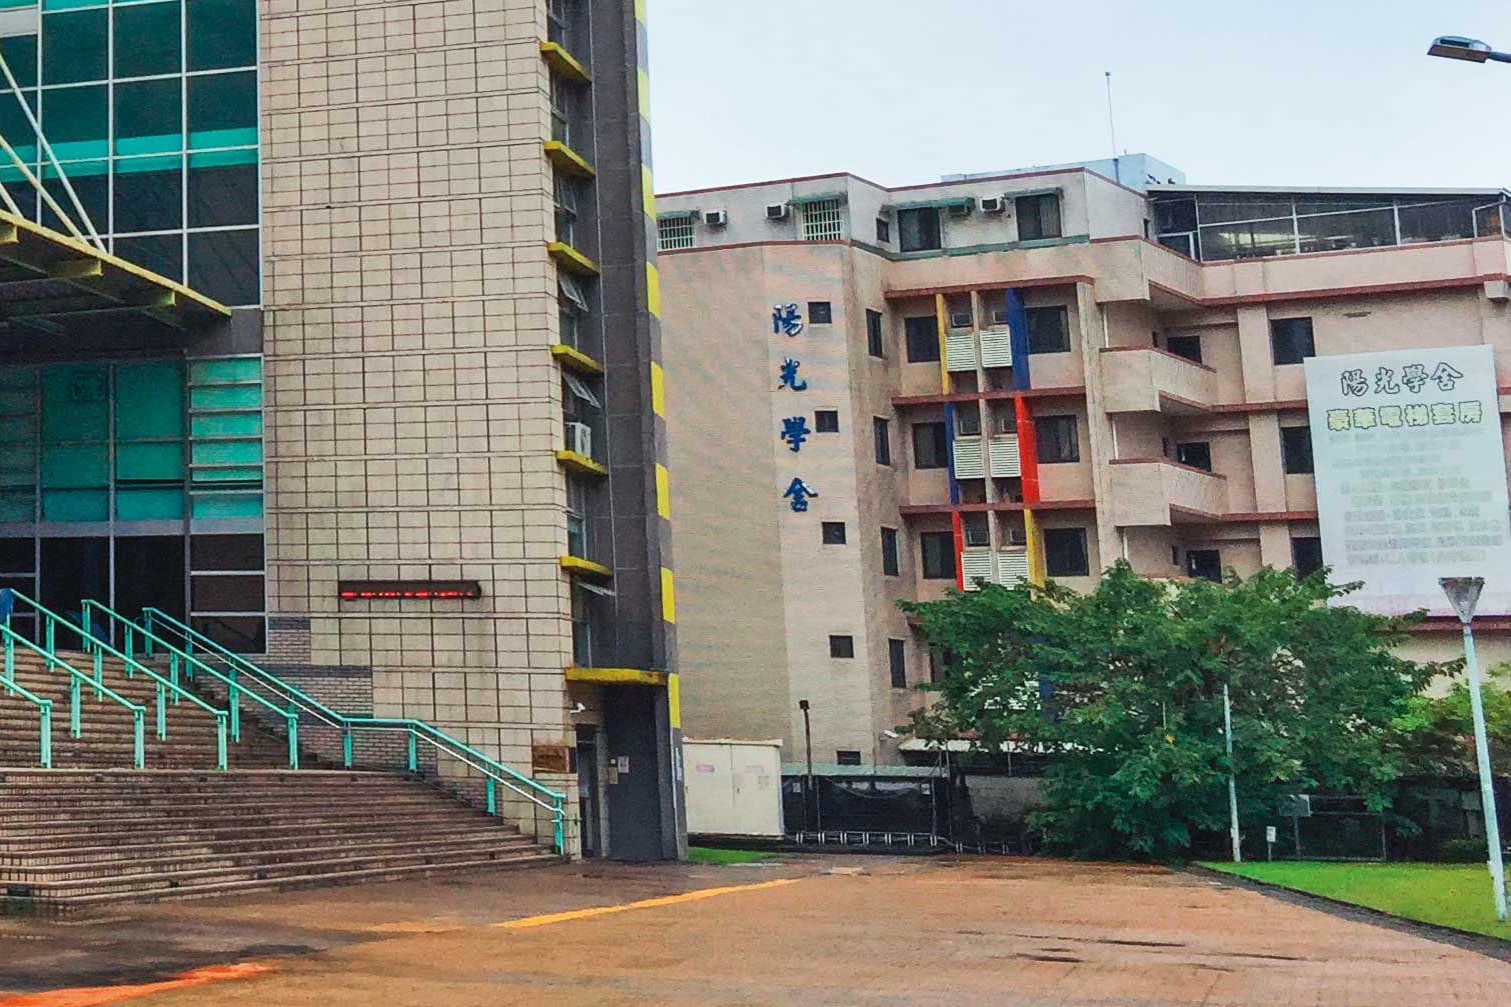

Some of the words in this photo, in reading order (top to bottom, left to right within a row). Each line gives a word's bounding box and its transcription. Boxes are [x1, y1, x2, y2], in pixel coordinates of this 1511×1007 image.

[772, 302, 819, 513] 陽光學舍
[1340, 362, 1464, 397] 陽光學舍
